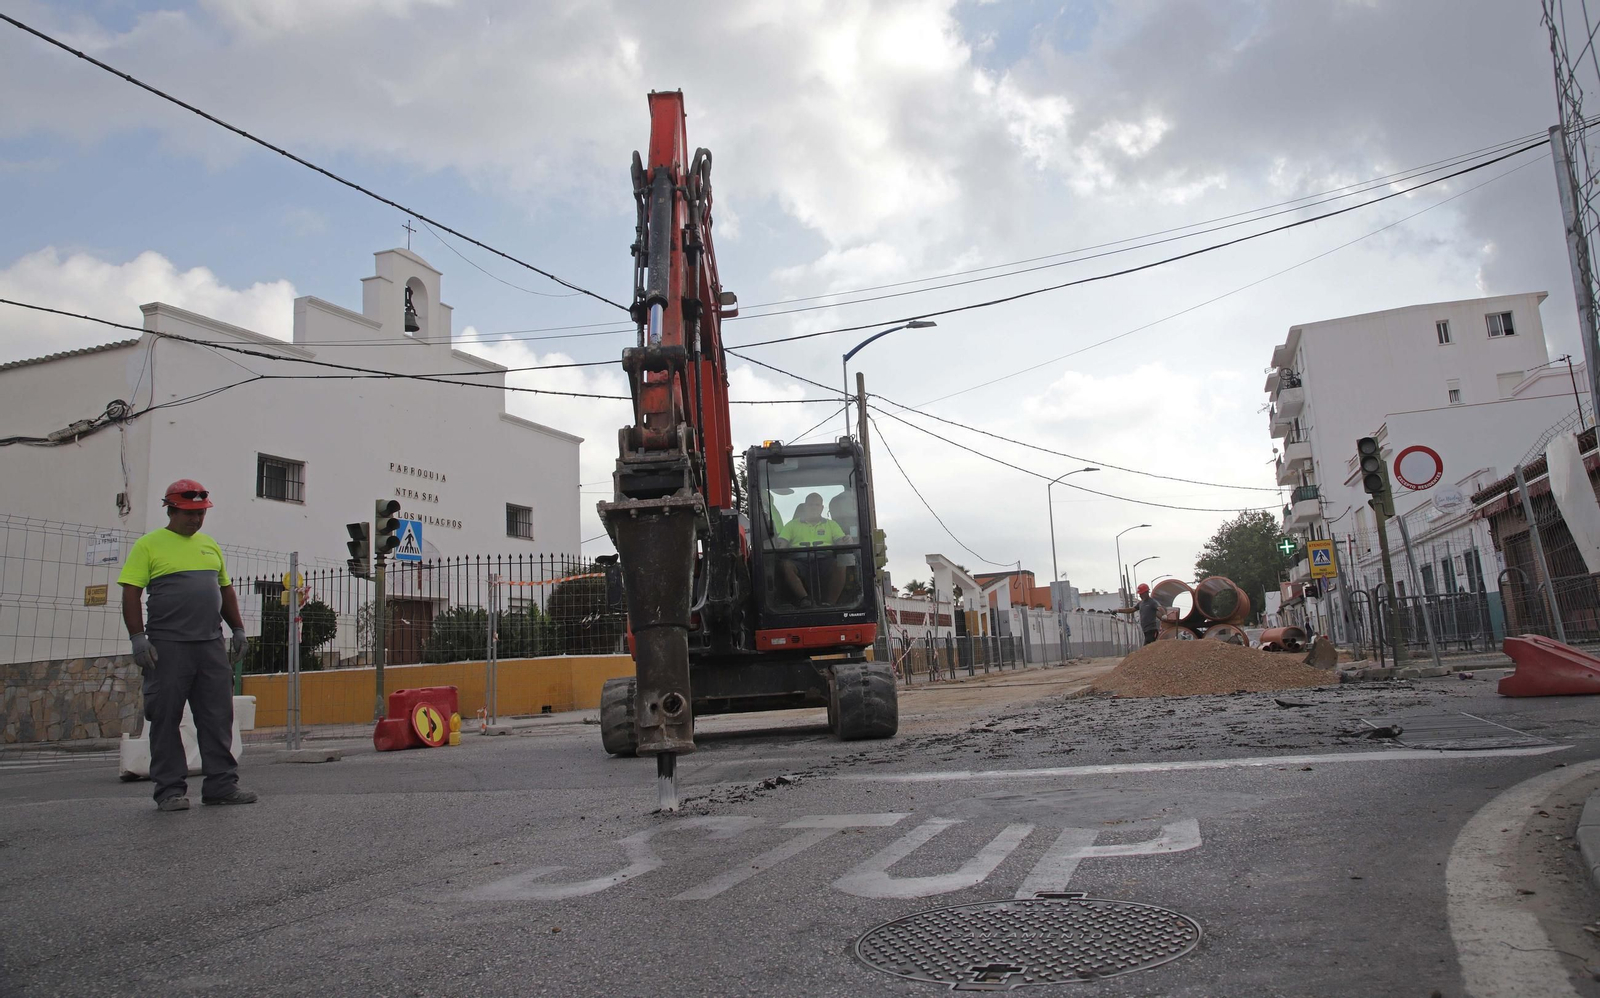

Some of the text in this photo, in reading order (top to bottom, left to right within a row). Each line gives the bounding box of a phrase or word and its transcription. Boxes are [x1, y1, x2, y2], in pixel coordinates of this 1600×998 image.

[389, 462, 446, 482] PARROQUIA
[1397, 471, 1442, 490] EXCEPTO RESIDENTES
[395, 487, 439, 503] NTRA SRA
[398, 511, 462, 529] LOS MILAGROS
